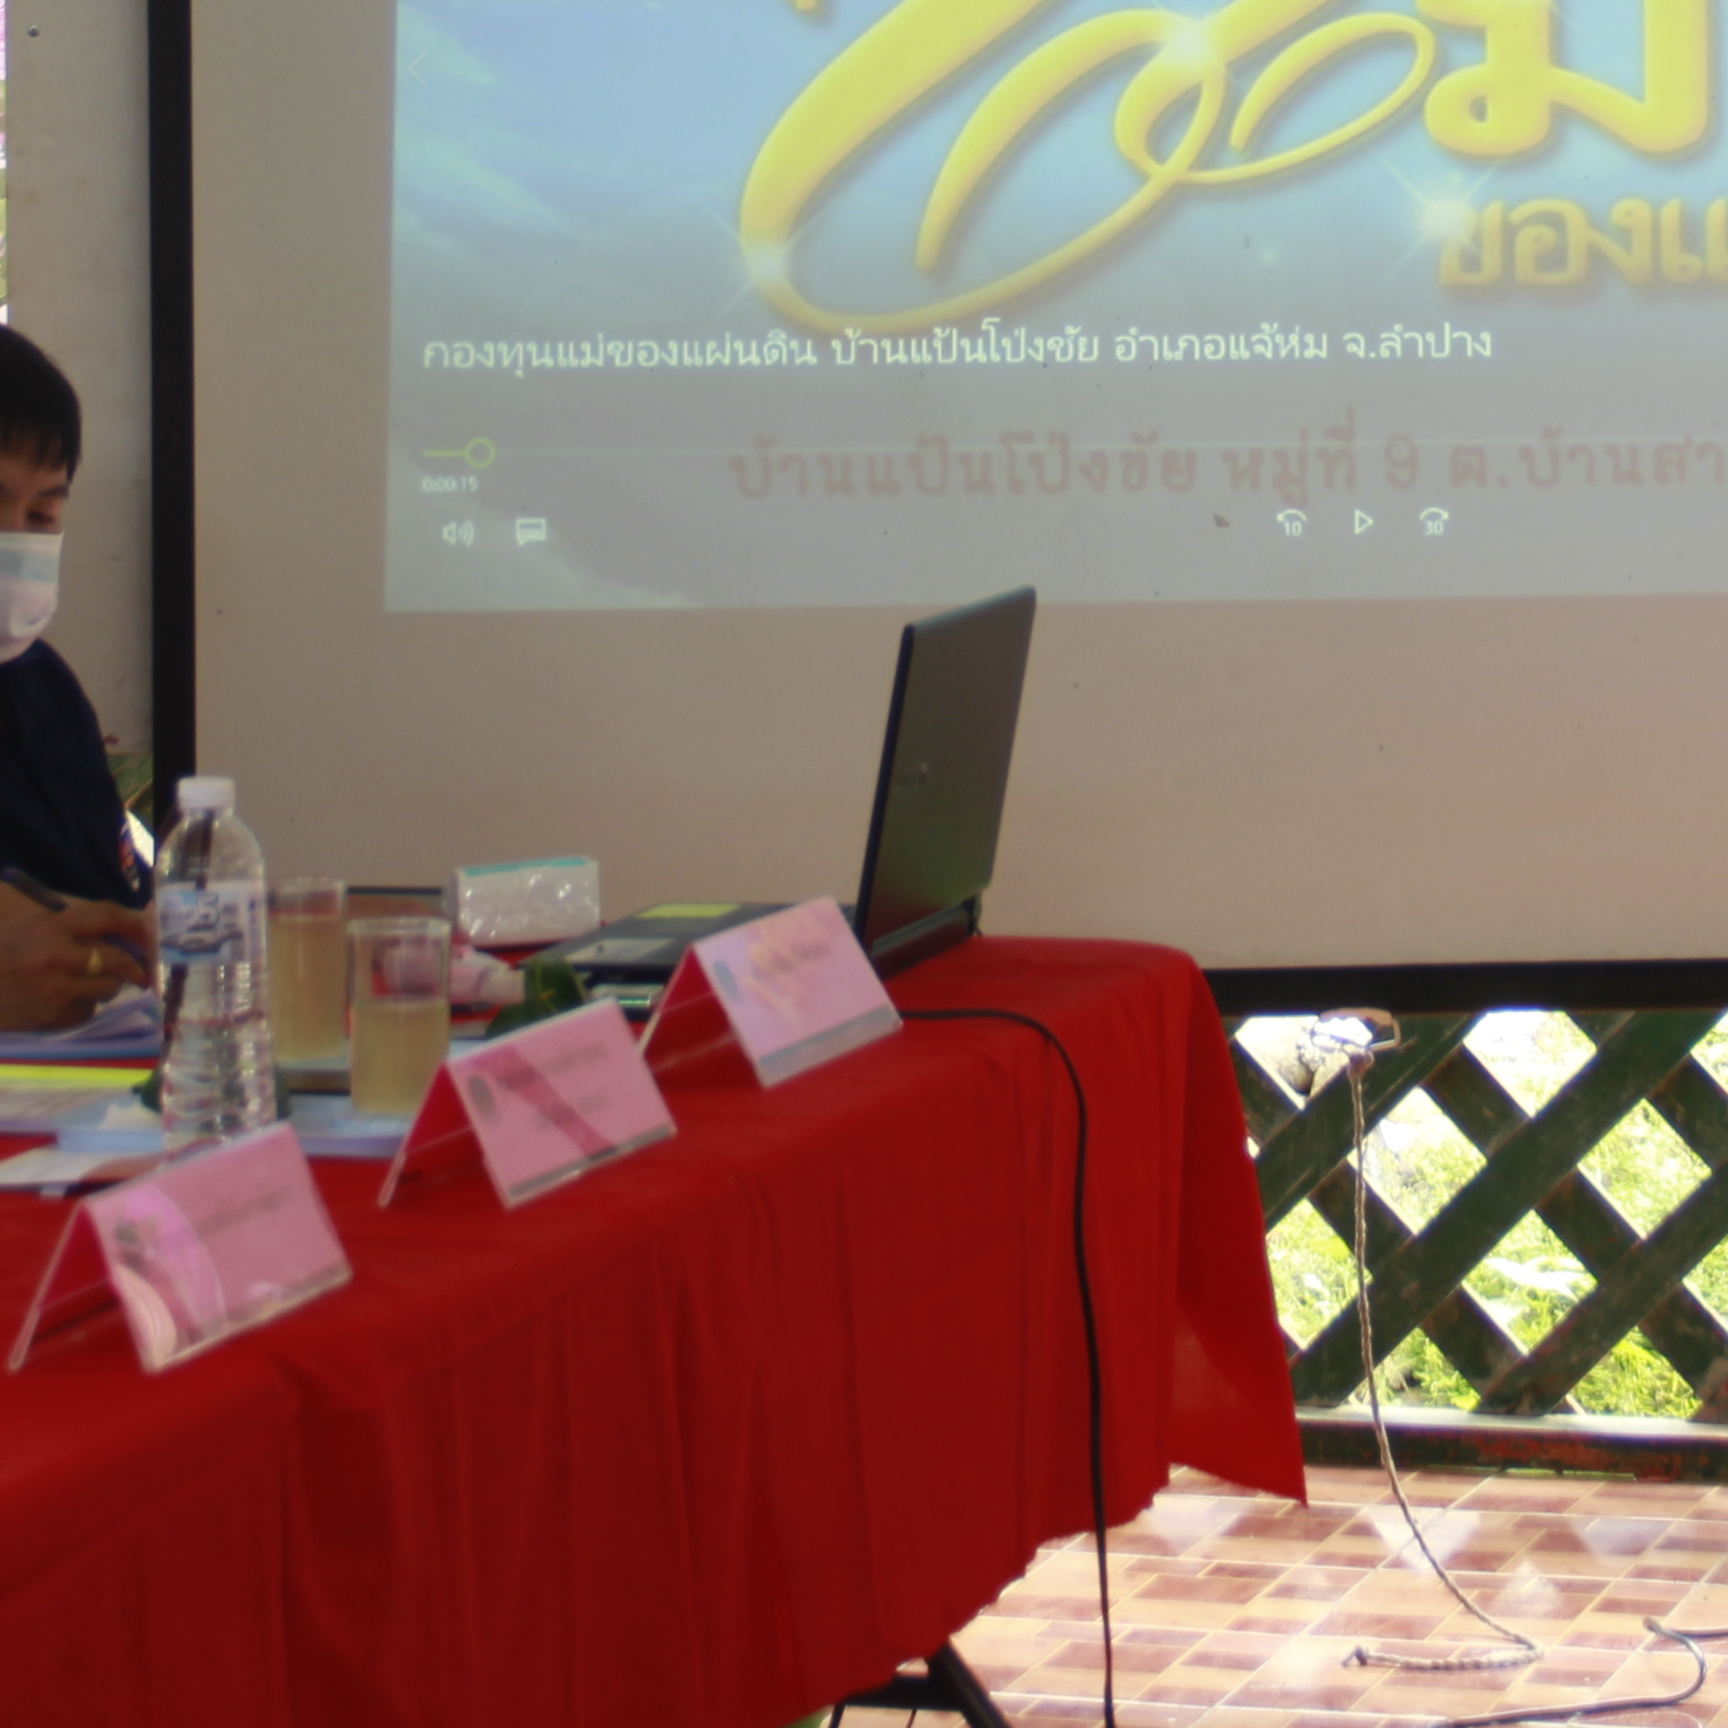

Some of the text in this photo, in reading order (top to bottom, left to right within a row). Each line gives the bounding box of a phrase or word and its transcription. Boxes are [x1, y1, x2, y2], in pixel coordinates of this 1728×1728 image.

[423, 318, 1494, 378] กองทุนแม่ของแผ่นดิน บ้านแป้นโป่งชัย อำเภอแจ้ห่ม จ.ลำปาง
[1221, 406, 1358, 508] หมู่ที่
[1383, 432, 1420, 491] 9
